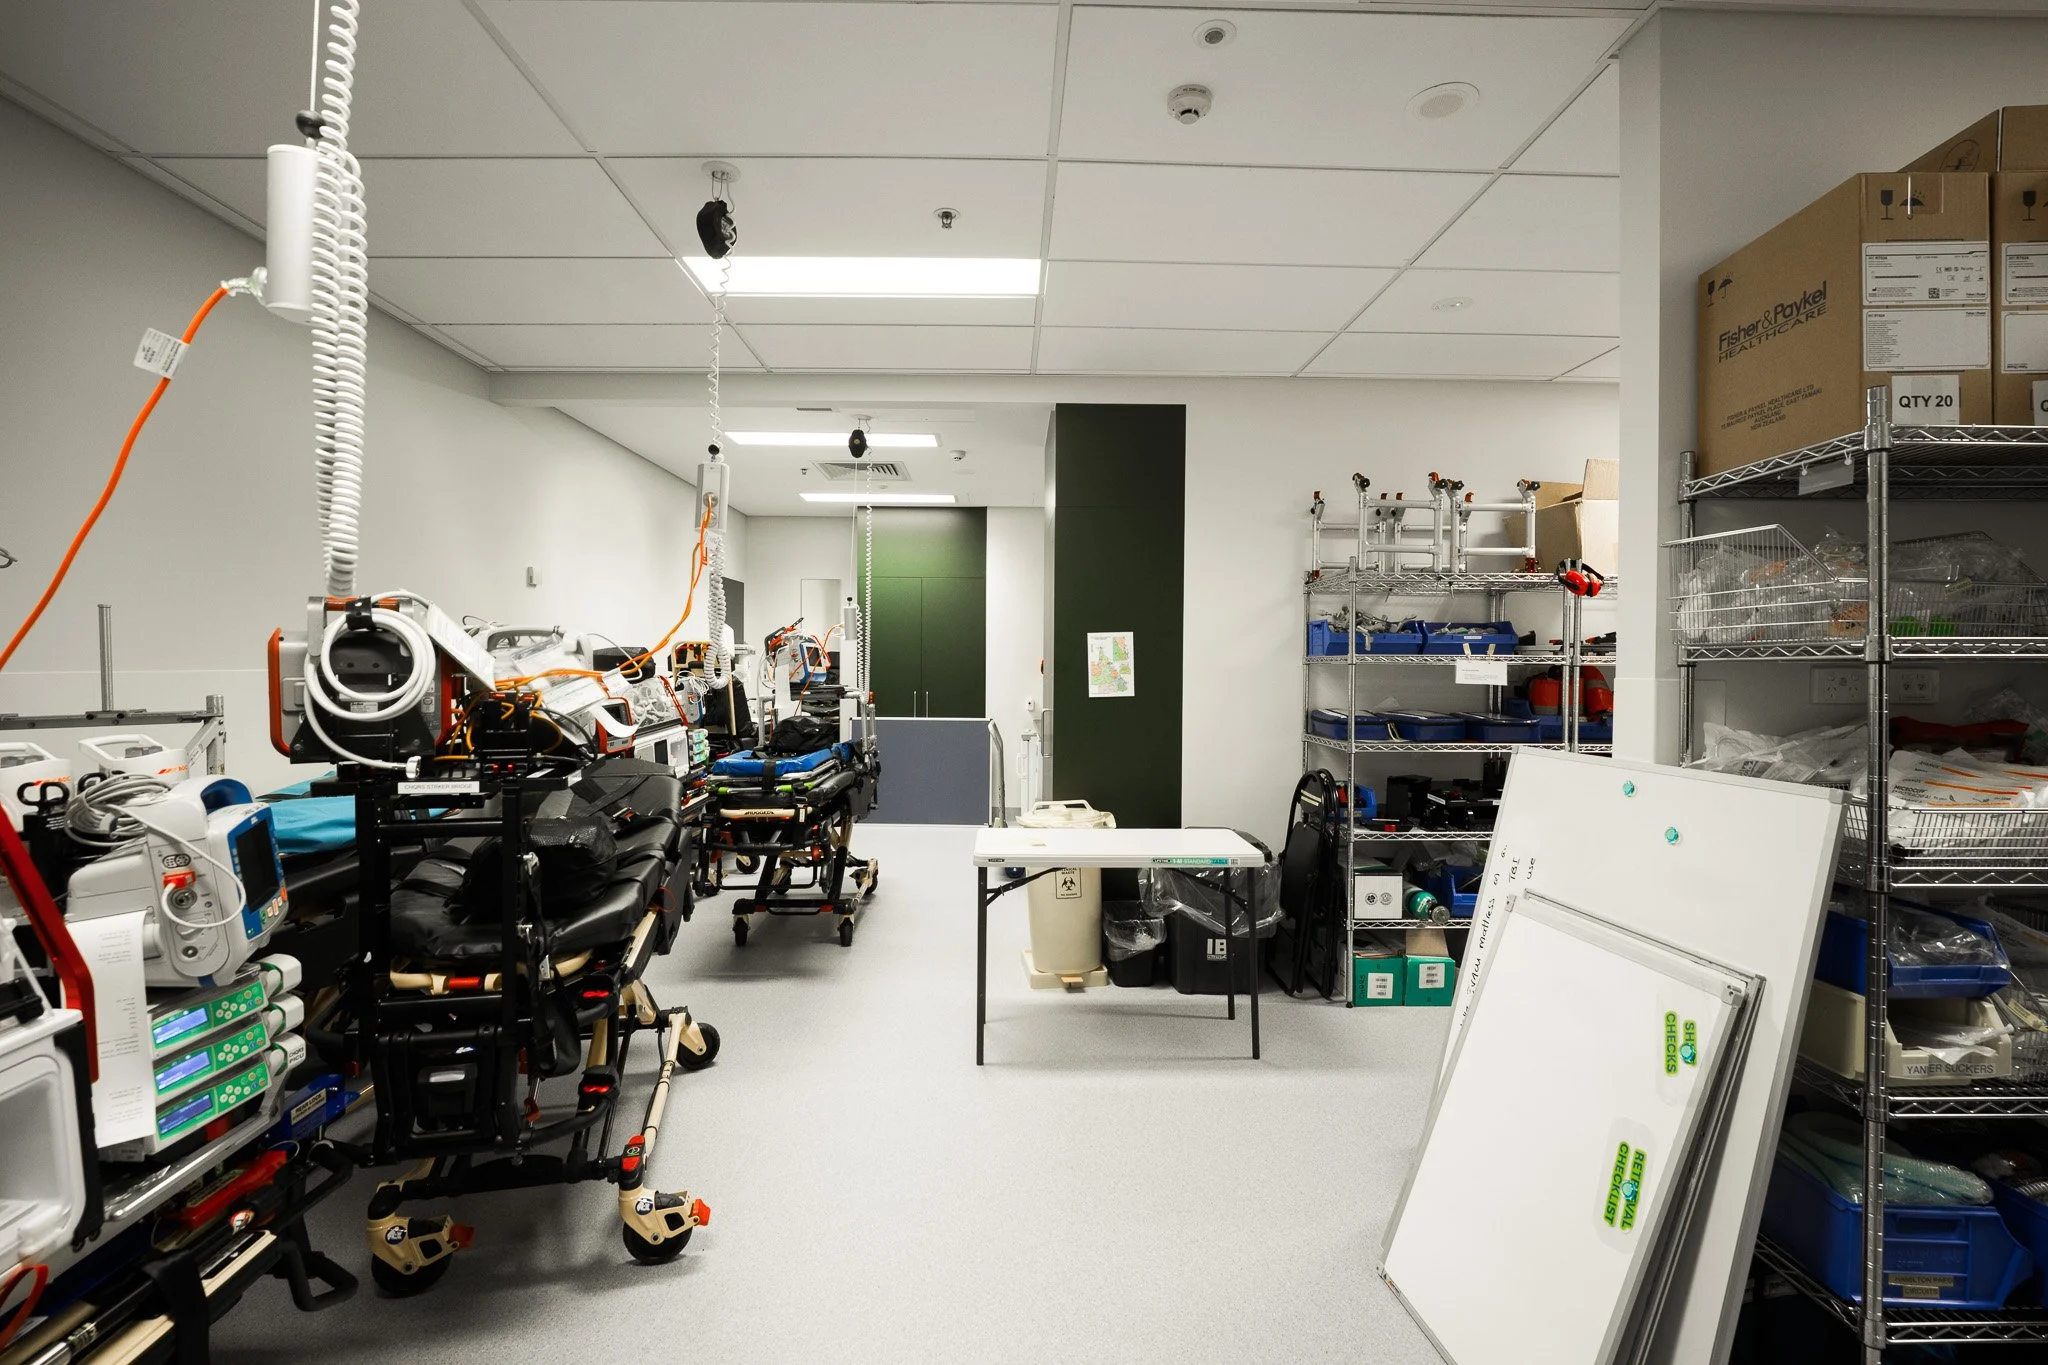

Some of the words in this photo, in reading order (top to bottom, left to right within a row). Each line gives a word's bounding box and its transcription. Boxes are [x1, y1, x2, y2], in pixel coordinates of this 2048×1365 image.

[1718, 318, 1761, 351] Fisher
[1761, 310, 1773, 330] &
[1773, 280, 1827, 324] Paykel
[1718, 304, 1827, 363] HEALTHCARE
[1899, 395, 1932, 409] QTY
[1935, 395, 1953, 408] 20
[1666, 1013, 1676, 1073] CHECKS
[1944, 1063, 1994, 1074] SUCKERS
[1604, 1143, 1629, 1225] CHECKLIST
[1621, 1151, 1645, 1229] RETRVAL
